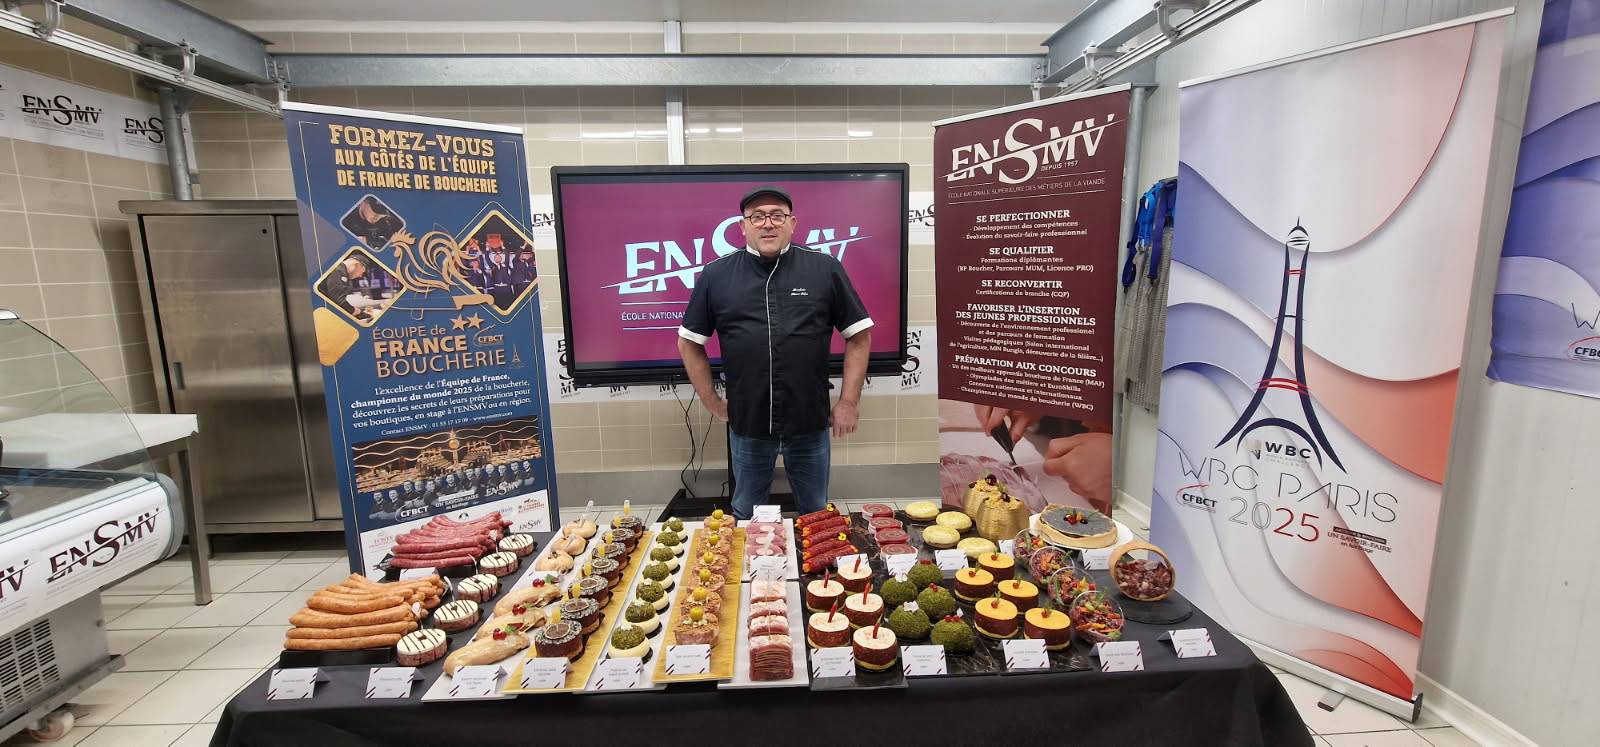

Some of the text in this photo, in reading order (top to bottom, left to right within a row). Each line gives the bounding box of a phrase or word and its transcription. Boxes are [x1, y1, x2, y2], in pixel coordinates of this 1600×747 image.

[21, 94, 102, 126] ENSMV
[328, 123, 495, 158] FORMEZ-VOUS
[945, 113, 1117, 185] ENSMV
[335, 149, 496, 175] AUX CÔTÉS DE L'ÉQUIPE
[1041, 162, 1062, 171] DEPUIS
[337, 170, 498, 194] DE FRANCE DE BOUCHERIE
[1037, 182, 1062, 190] MÉTIERS
[1083, 178, 1106, 186] VIANDE
[976, 209, 1071, 223] SE PERFECTIONNER
[973, 225, 1020, 233] Développement
[1033, 221, 1078, 230] compétences
[1004, 230, 1039, 238] savoir-faire
[1040, 229, 1087, 239] professionnel
[989, 245, 1054, 256] SE QUALIFIER
[1019, 256, 1063, 265] diplômantes
[981, 279, 1063, 288] SE RECONVERTIR
[621, 311, 686, 321] ÉCOLE NATIONA
[967, 304, 1080, 316] FAVORISER L'INSERTION
[956, 311, 1096, 326] DES JEUNES PROFESSIONNELS
[372, 325, 446, 342] ÉQUIPE de
[1033, 333, 1065, 341] formation
[374, 335, 467, 359] FRANCE
[1026, 348, 1059, 357] découverte
[1045, 342, 1090, 351] international
[376, 349, 506, 377] BOUCHERIE
[955, 354, 1097, 377] PRÉPARATION AUX CONCOURS
[425, 381, 435, 390] de
[482, 374, 510, 382] France,
[1062, 376, 1084, 384] France
[351, 396, 408, 409] championne
[423, 390, 452, 399] monde
[454, 386, 473, 395] 2025
[474, 385, 483, 393] de
[352, 406, 396, 419] découvrez
[410, 401, 438, 411] secrets
[439, 399, 448, 407] de
[450, 397, 468, 405] leurs
[469, 391, 513, 403] préparations
[514, 389, 530, 398] pour
[1039, 397, 1071, 407] boucherie
[369, 415, 413, 426] boutiques,
[426, 410, 446, 419] stage
[453, 402, 488, 413] l'ENSMV
[1265, 441, 1312, 459] WBC
[1179, 451, 1399, 523] WBC PARIS
[1182, 493, 1218, 507] CFBCT
[400, 506, 428, 517] CFBCT
[1229, 496, 1320, 543] 2025
[47, 508, 160, 585] ENSMV
[1327, 531, 1338, 539] UN
[1340, 534, 1392, 553] SAVOIR-FAIRE
